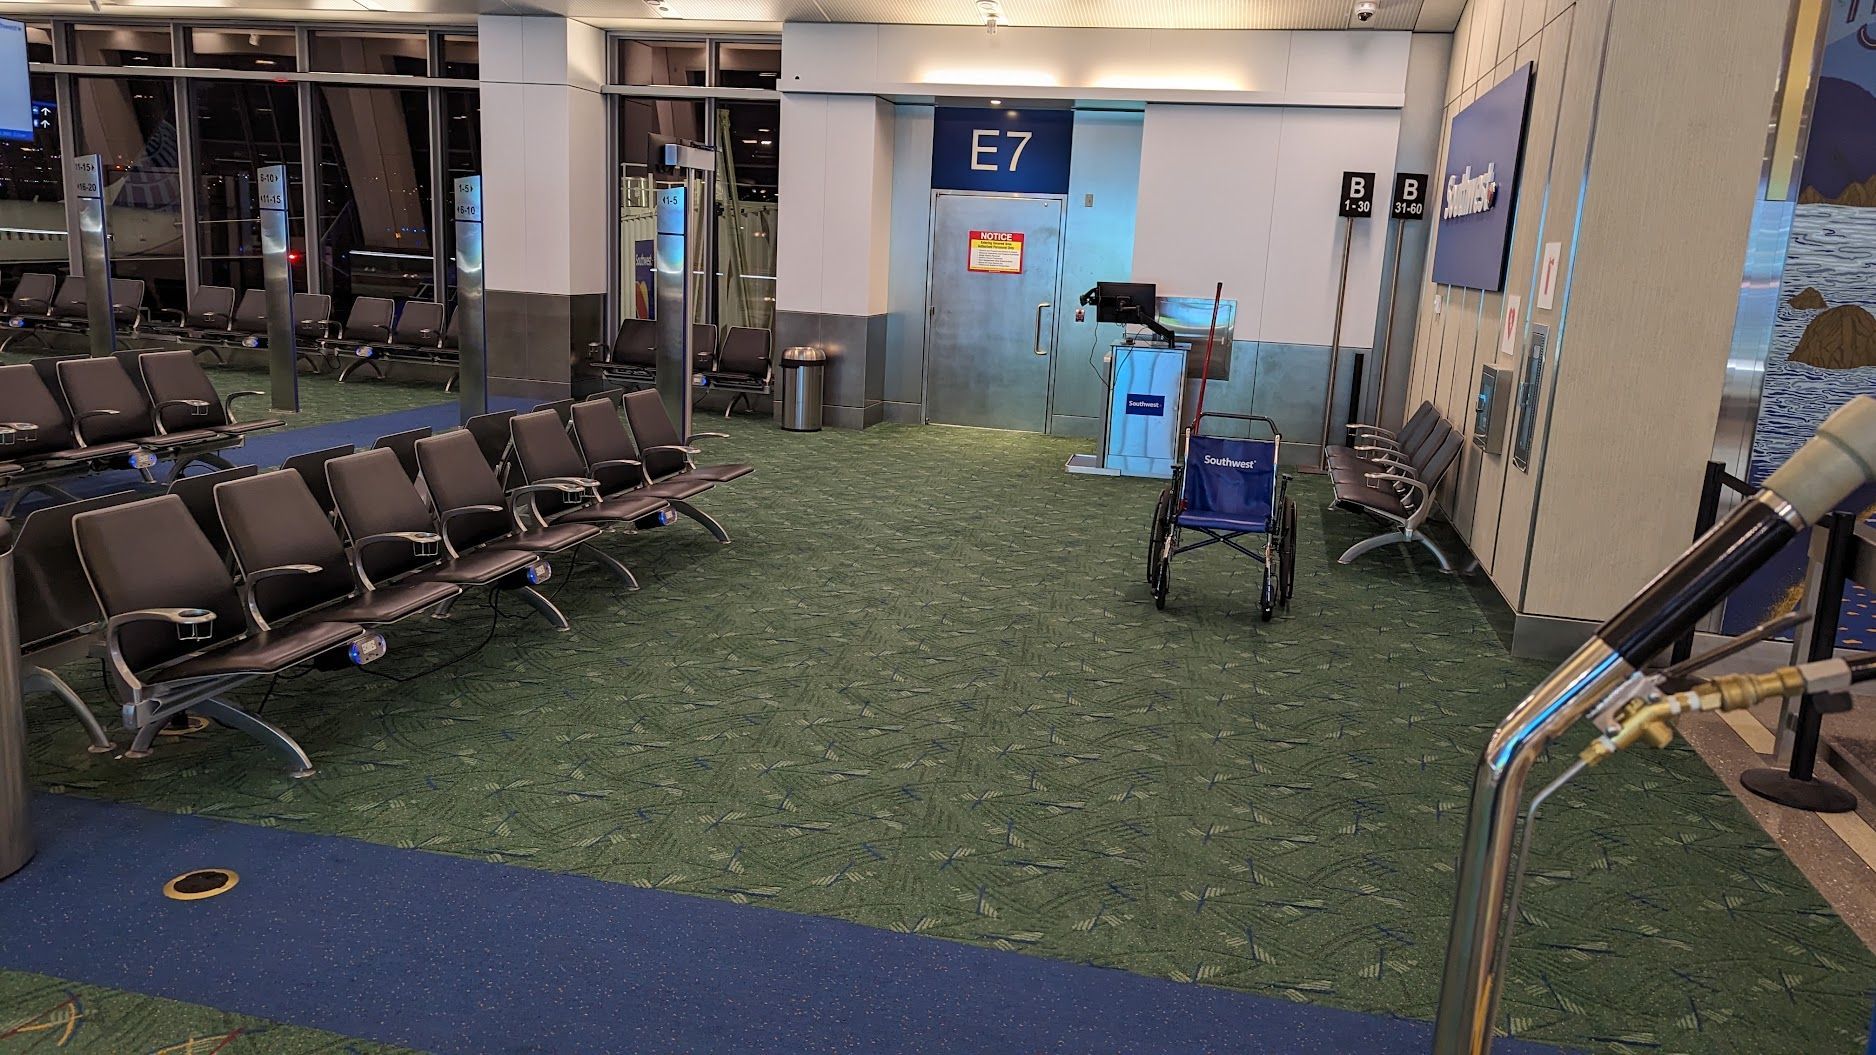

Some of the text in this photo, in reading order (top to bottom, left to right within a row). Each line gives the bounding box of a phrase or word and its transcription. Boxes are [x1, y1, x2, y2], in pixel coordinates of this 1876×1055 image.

[971, 129, 1032, 171] E7
[1350, 177, 1365, 198] B
[1403, 179, 1418, 200] B
[1444, 163, 1495, 219] Southwest
[666, 195, 678, 205] 1-5
[1394, 202, 1423, 214] 31-60
[980, 232, 1013, 241] NOTICE
[1129, 400, 1160, 408] Southwest
[1204, 455, 1255, 469] Southwest
